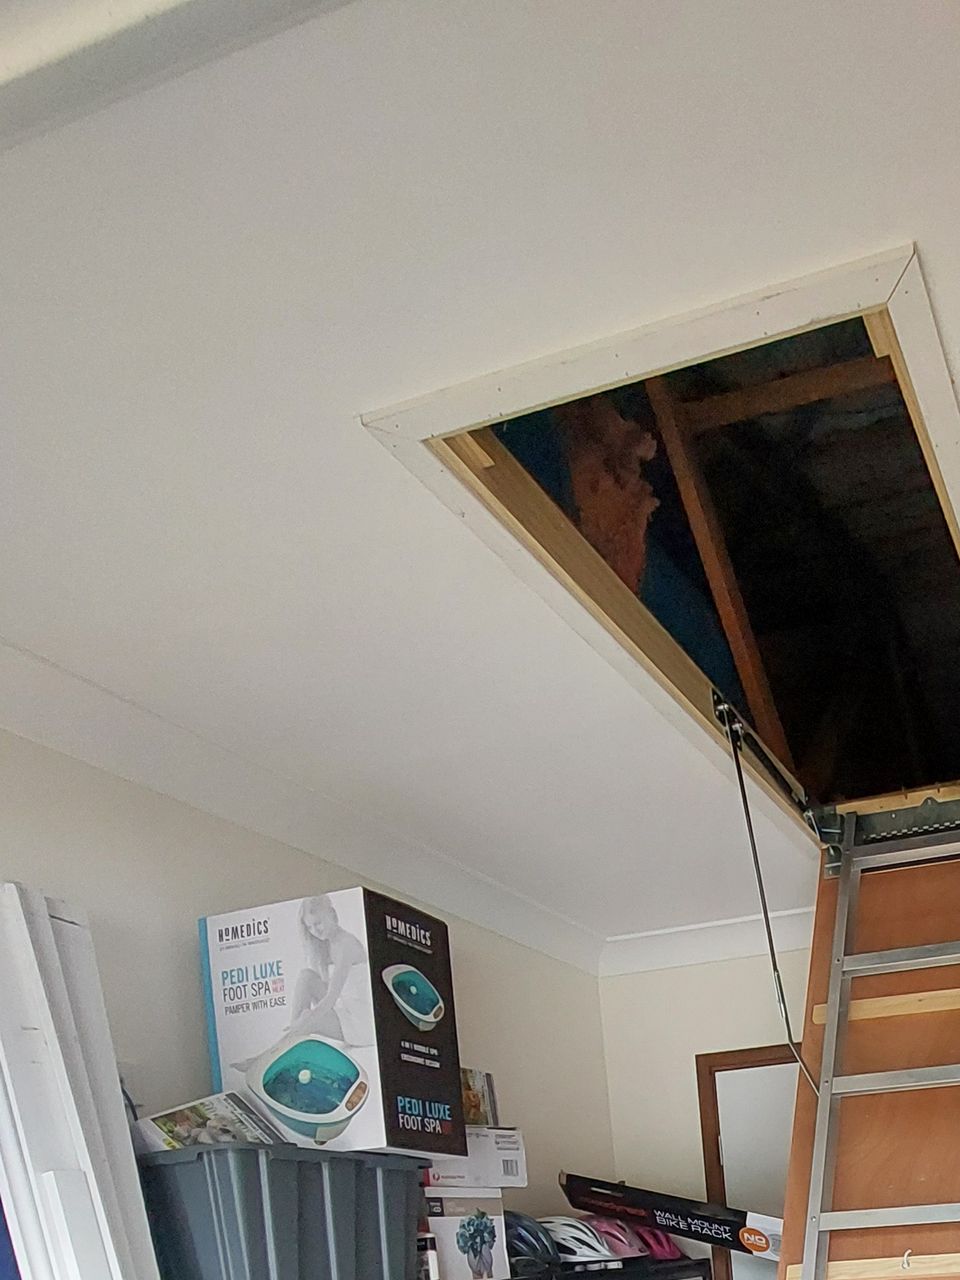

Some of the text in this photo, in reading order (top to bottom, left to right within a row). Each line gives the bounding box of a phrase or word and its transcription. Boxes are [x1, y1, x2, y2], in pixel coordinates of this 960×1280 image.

[218, 918, 269, 942] HOMEDICS
[222, 960, 284, 986] PEDI LUXE
[223, 981, 271, 1002] FOOT SPA
[225, 996, 286, 1015] PAMPER WITH EASE
[397, 1095, 452, 1120] PEDI LUXE
[398, 1114, 421, 1131] FOOT
[424, 1117, 442, 1134] SPA
[653, 1209, 732, 1233] WALL MOUNT
[656, 1216, 733, 1241] BIKE RACK
[743, 1232, 766, 1244] NO
